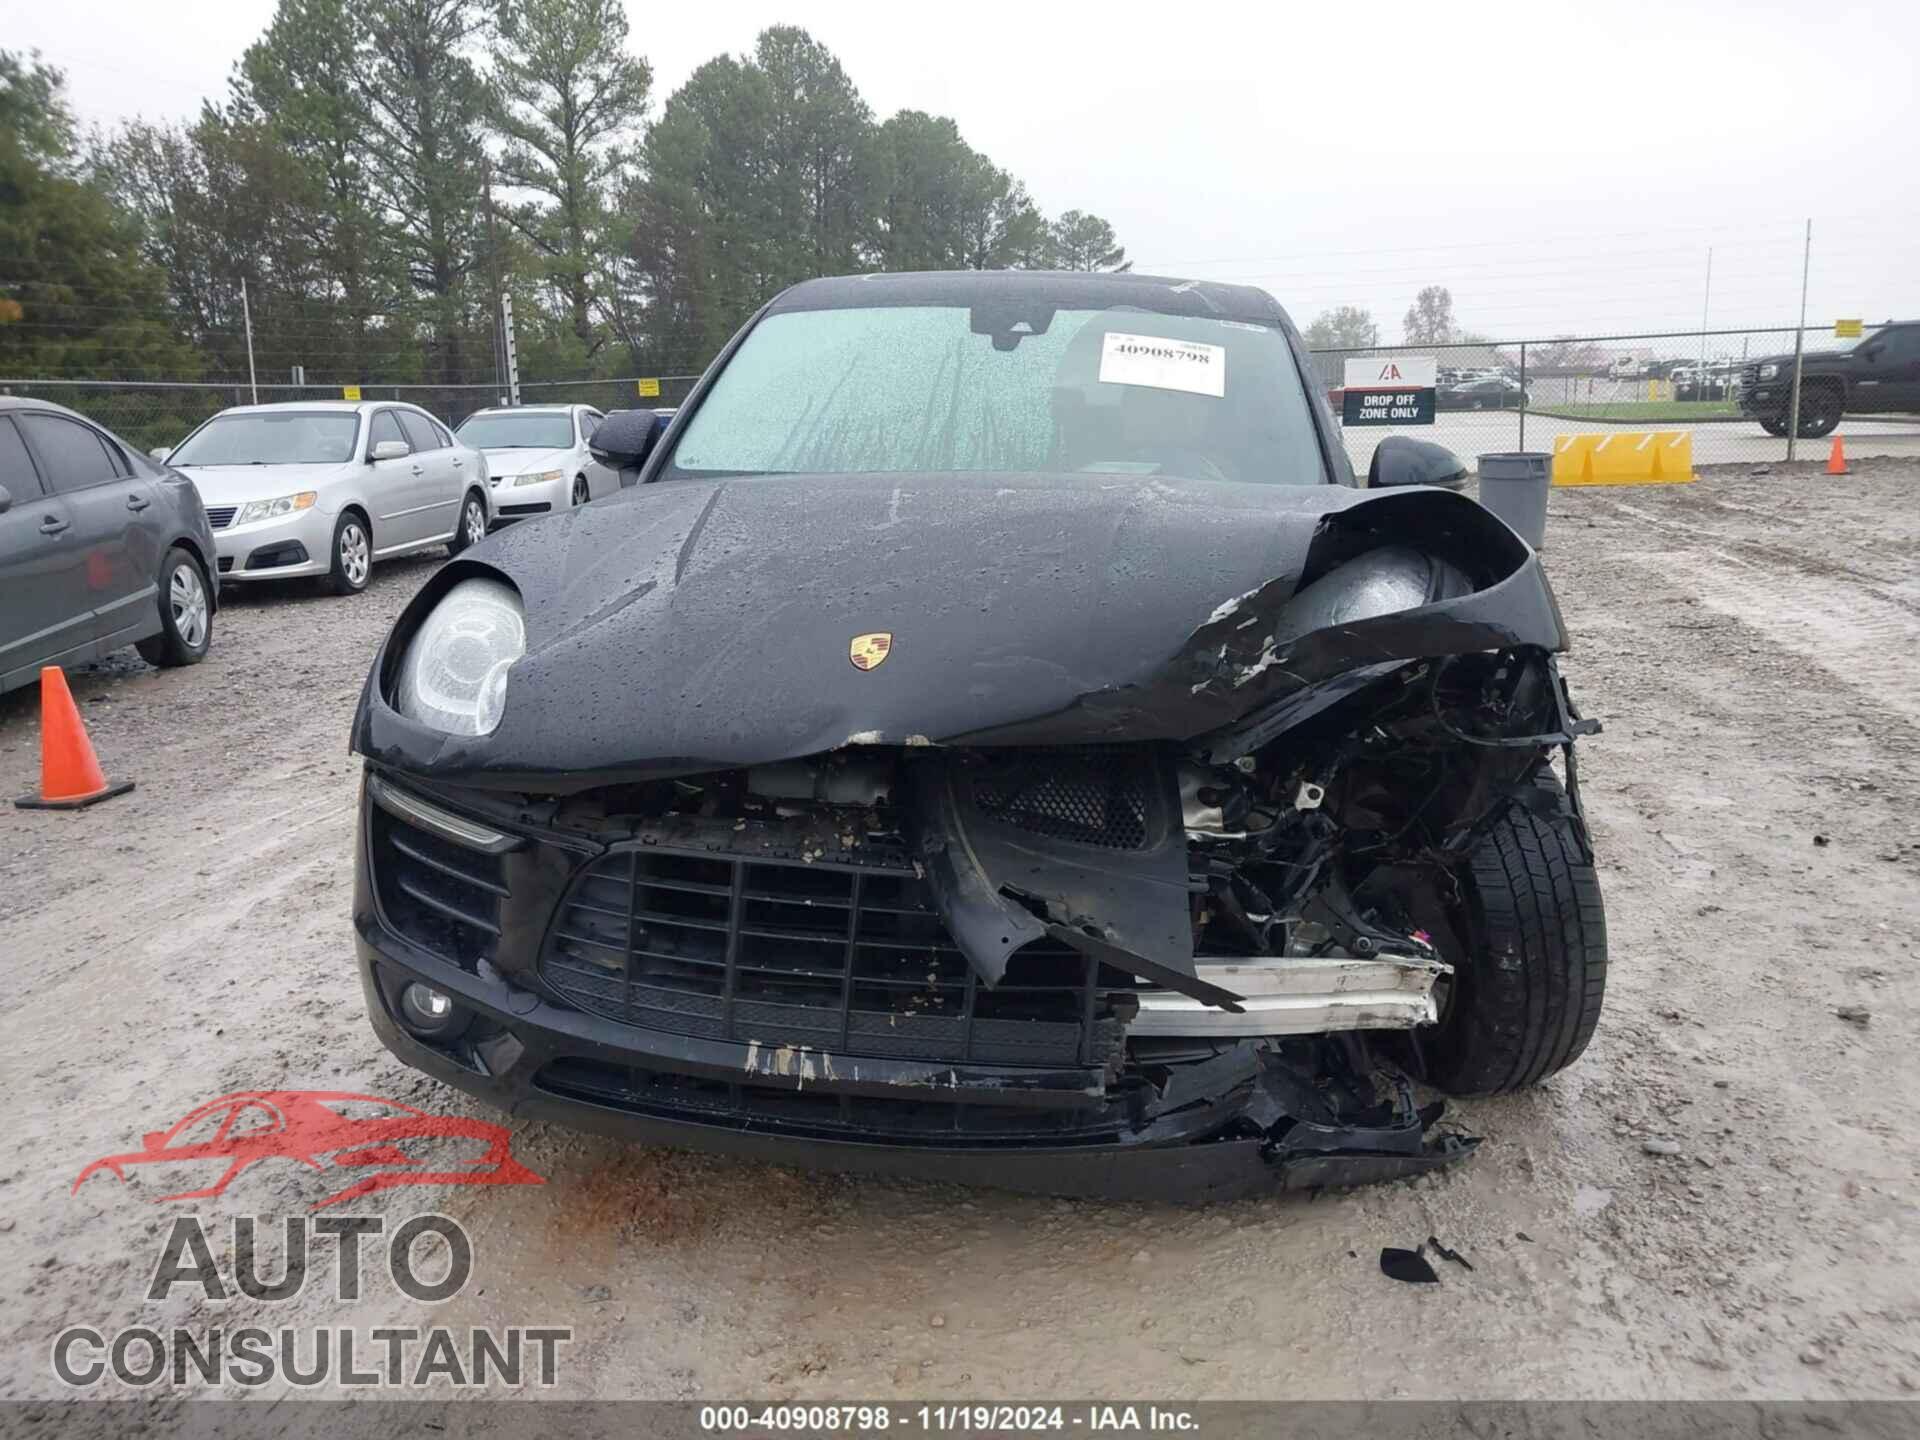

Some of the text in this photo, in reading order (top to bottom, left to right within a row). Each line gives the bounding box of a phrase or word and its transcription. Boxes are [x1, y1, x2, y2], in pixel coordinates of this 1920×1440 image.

[1115, 344, 1210, 364] 40908798
[1364, 395, 1415, 406] DROP OFF
[1359, 407, 1419, 419] ZONE ONLY
